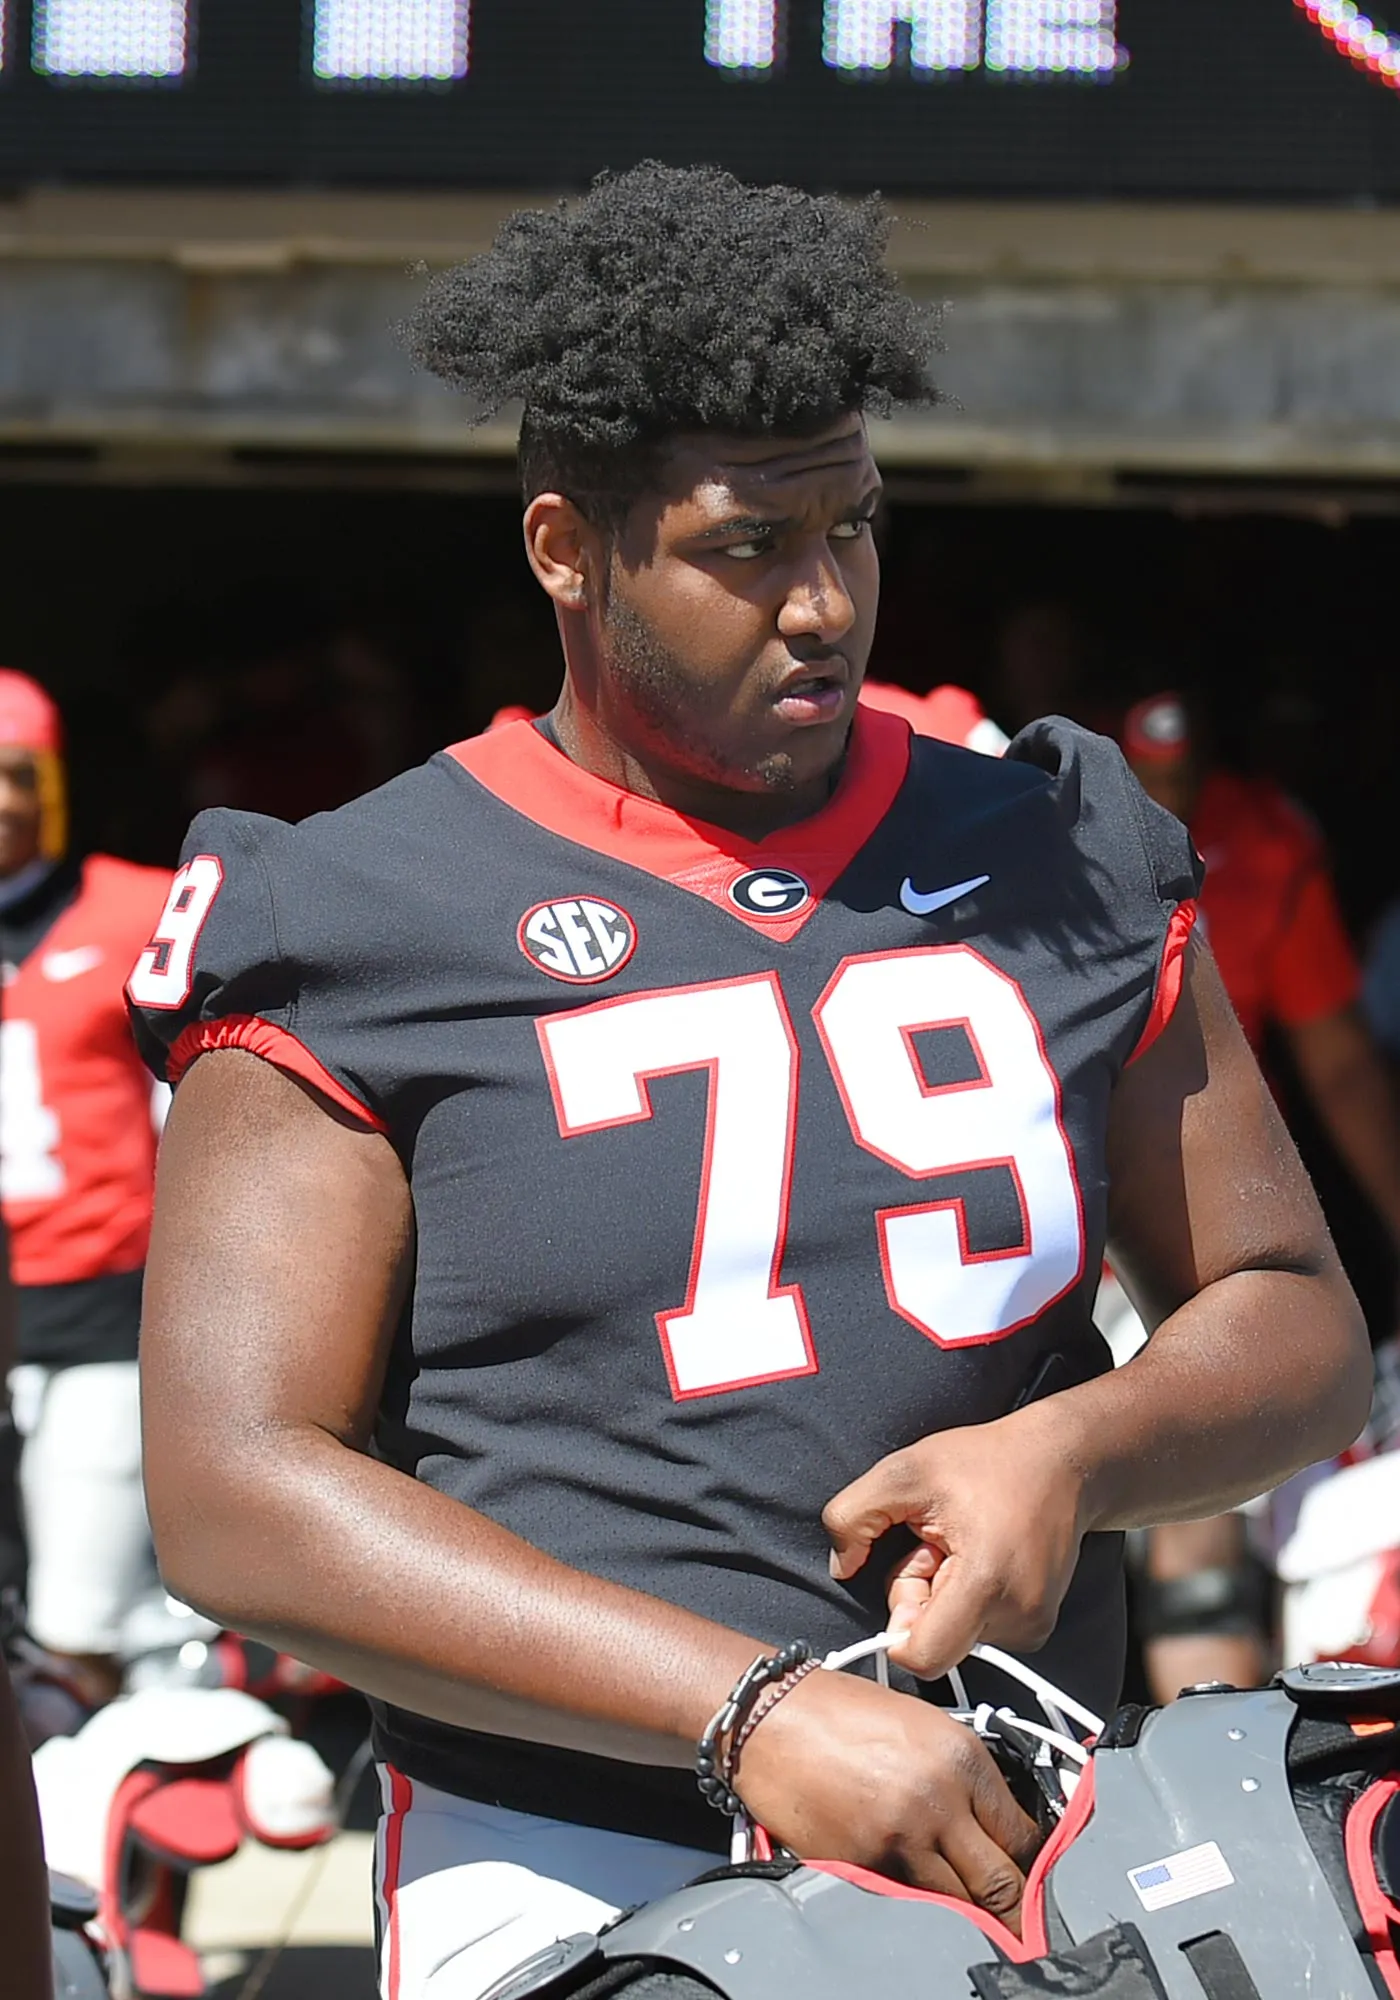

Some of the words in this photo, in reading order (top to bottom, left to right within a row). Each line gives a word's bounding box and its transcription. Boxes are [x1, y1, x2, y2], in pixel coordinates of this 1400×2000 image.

[730, 867, 809, 916] G
[525, 900, 627, 976] SEC
[534, 943, 1085, 1401] 79
